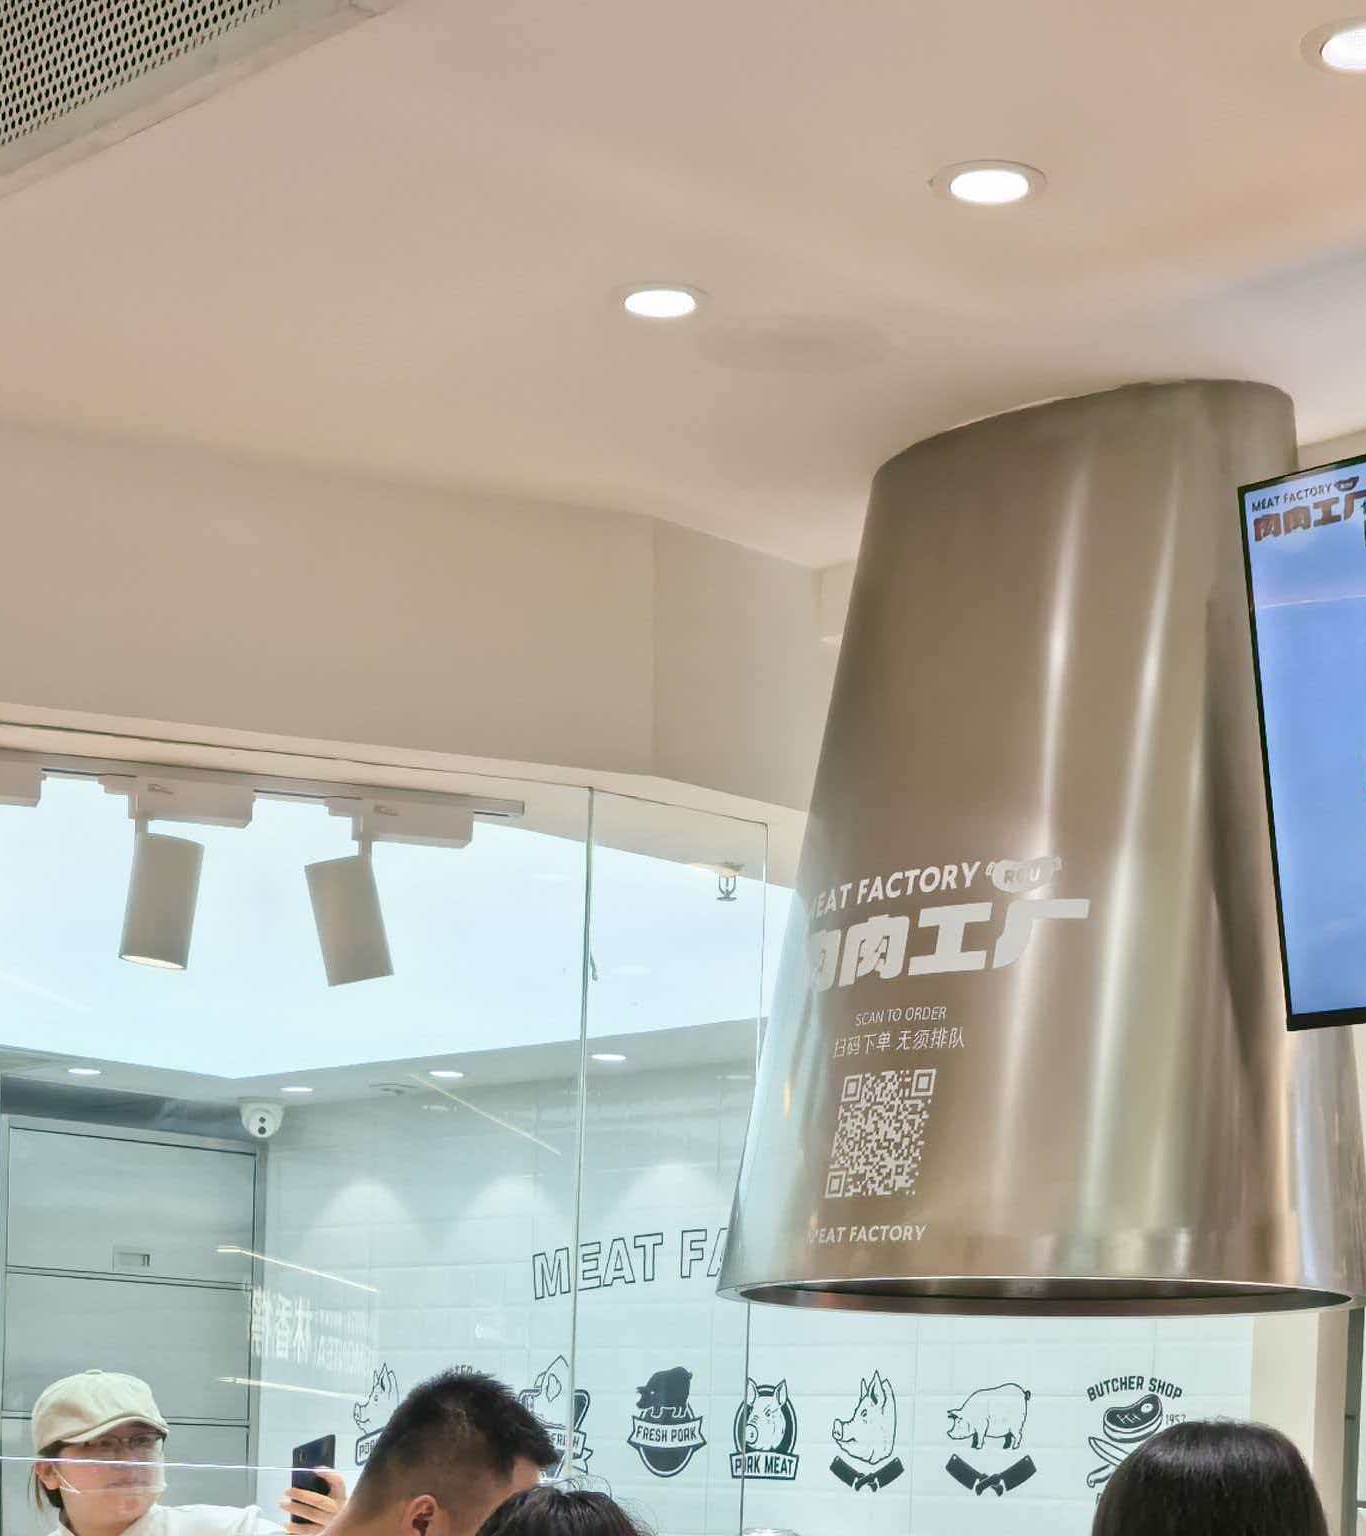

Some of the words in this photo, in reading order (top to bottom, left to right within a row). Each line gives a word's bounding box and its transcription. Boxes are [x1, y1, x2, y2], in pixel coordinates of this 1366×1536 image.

[1251, 495, 1281, 512] MEAT
[1283, 483, 1332, 504] FACTORY
[810, 882, 853, 918] EAT
[856, 861, 981, 904] FACTORY
[855, 1008, 884, 1027] SCAN
[886, 1007, 903, 1022] TO
[904, 1006, 948, 1022] ORDER
[833, 1031, 891, 1058] 扫码下单
[896, 1026, 965, 1052] 无须排队
[849, 1224, 927, 1242] FACTORY
[533, 1232, 664, 1300] MEAT
[1087, 1375, 1145, 1402] BUTCHER
[1148, 1377, 1183, 1400] SHOP
[635, 1424, 668, 1442] FRESH
[670, 1425, 697, 1443] PORK
[764, 1455, 794, 1476] MEAT
